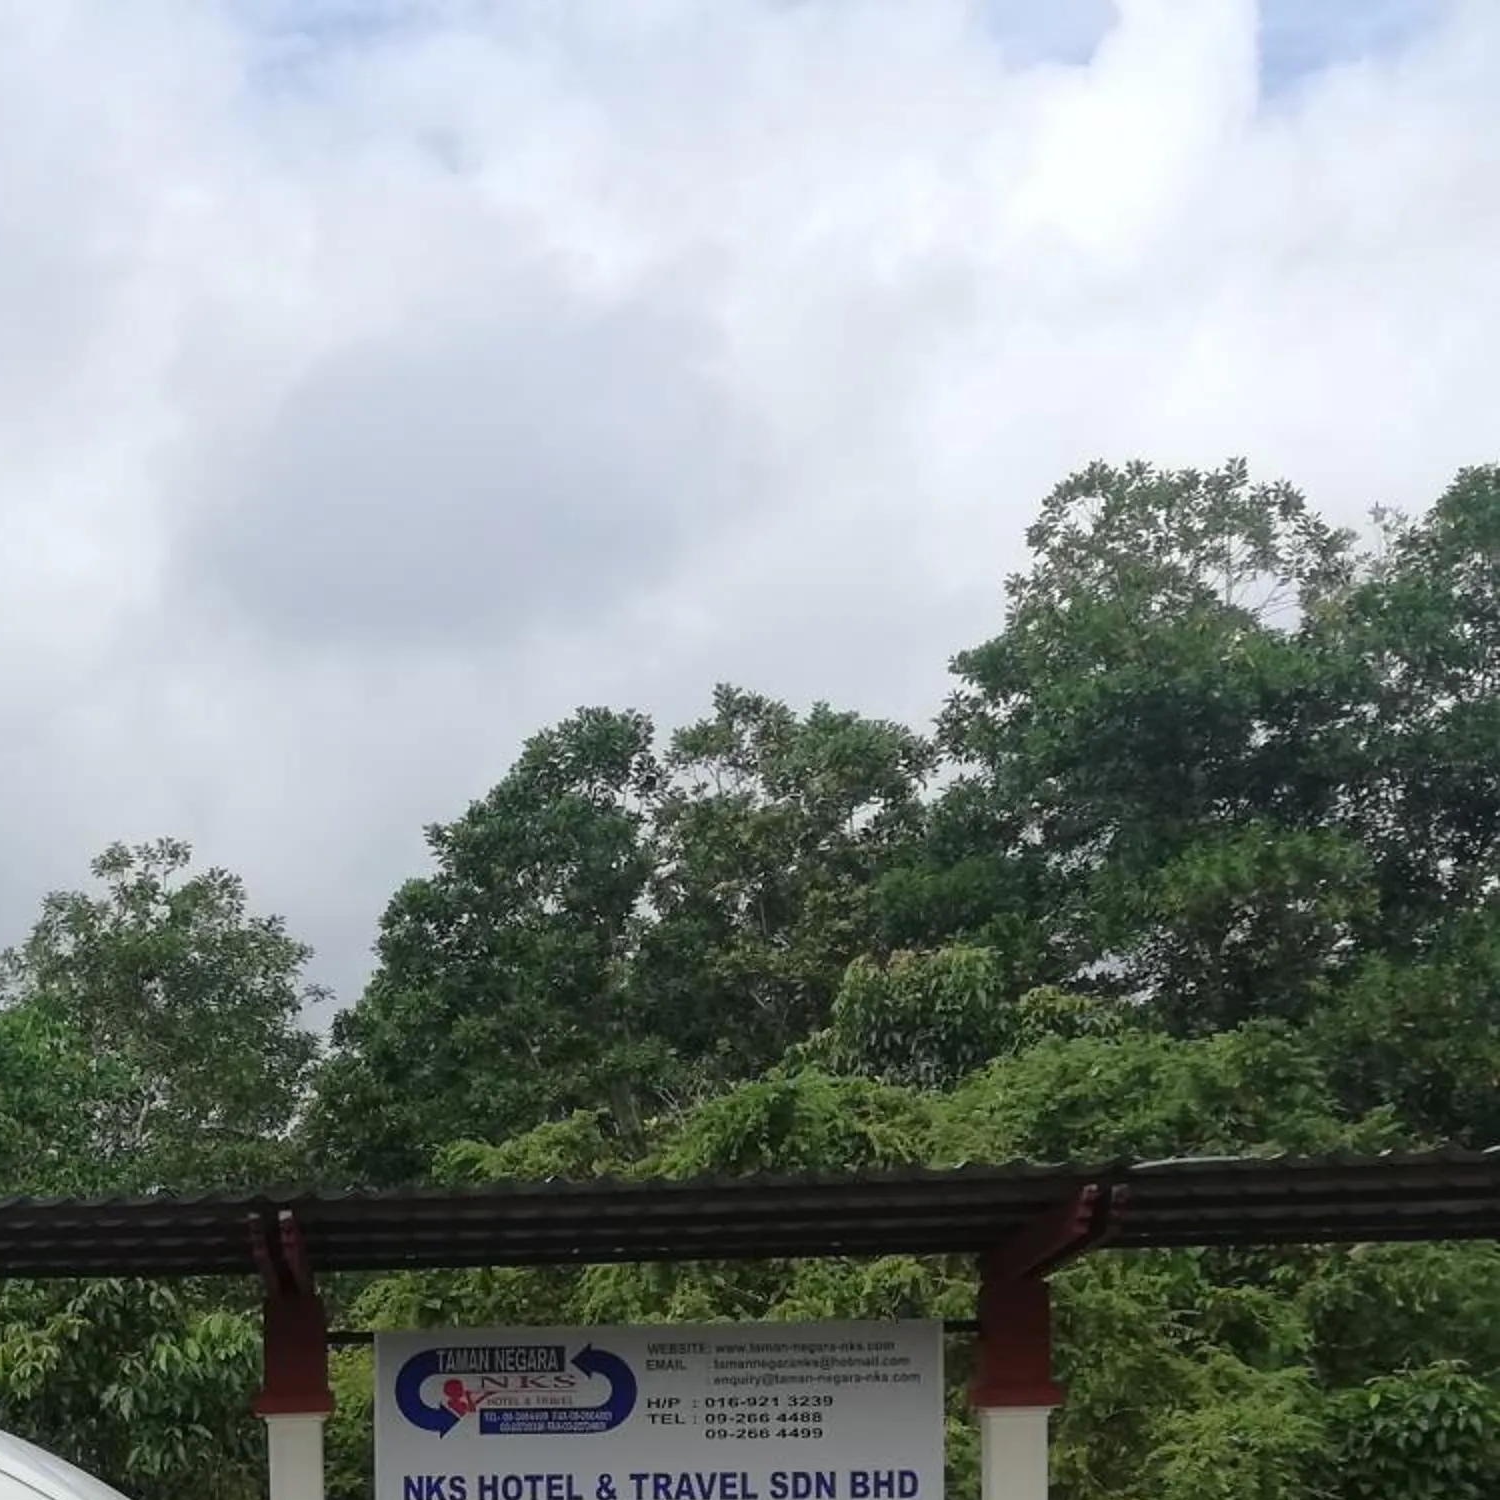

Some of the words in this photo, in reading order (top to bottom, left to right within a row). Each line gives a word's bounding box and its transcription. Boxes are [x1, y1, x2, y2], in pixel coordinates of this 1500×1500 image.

[436, 1350, 490, 1372] TAMAN
[493, 1350, 560, 1372] NEGARA
[645, 1359, 687, 1371] EMAIL
[481, 1375, 577, 1390] NKS
[647, 1398, 681, 1409] H/P
[705, 1397, 779, 1408] 016-921
[787, 1396, 833, 1408] 3239
[649, 1413, 686, 1425] TEL
[705, 1413, 770, 1424] 09-266
[775, 1412, 823, 1424] 4488
[705, 1428, 770, 1440] 09-266
[775, 1427, 823, 1439] 4499
[596, 1473, 617, 1500] &
[769, 1471, 836, 1500] SDN
[851, 1470, 919, 1499] BHD
